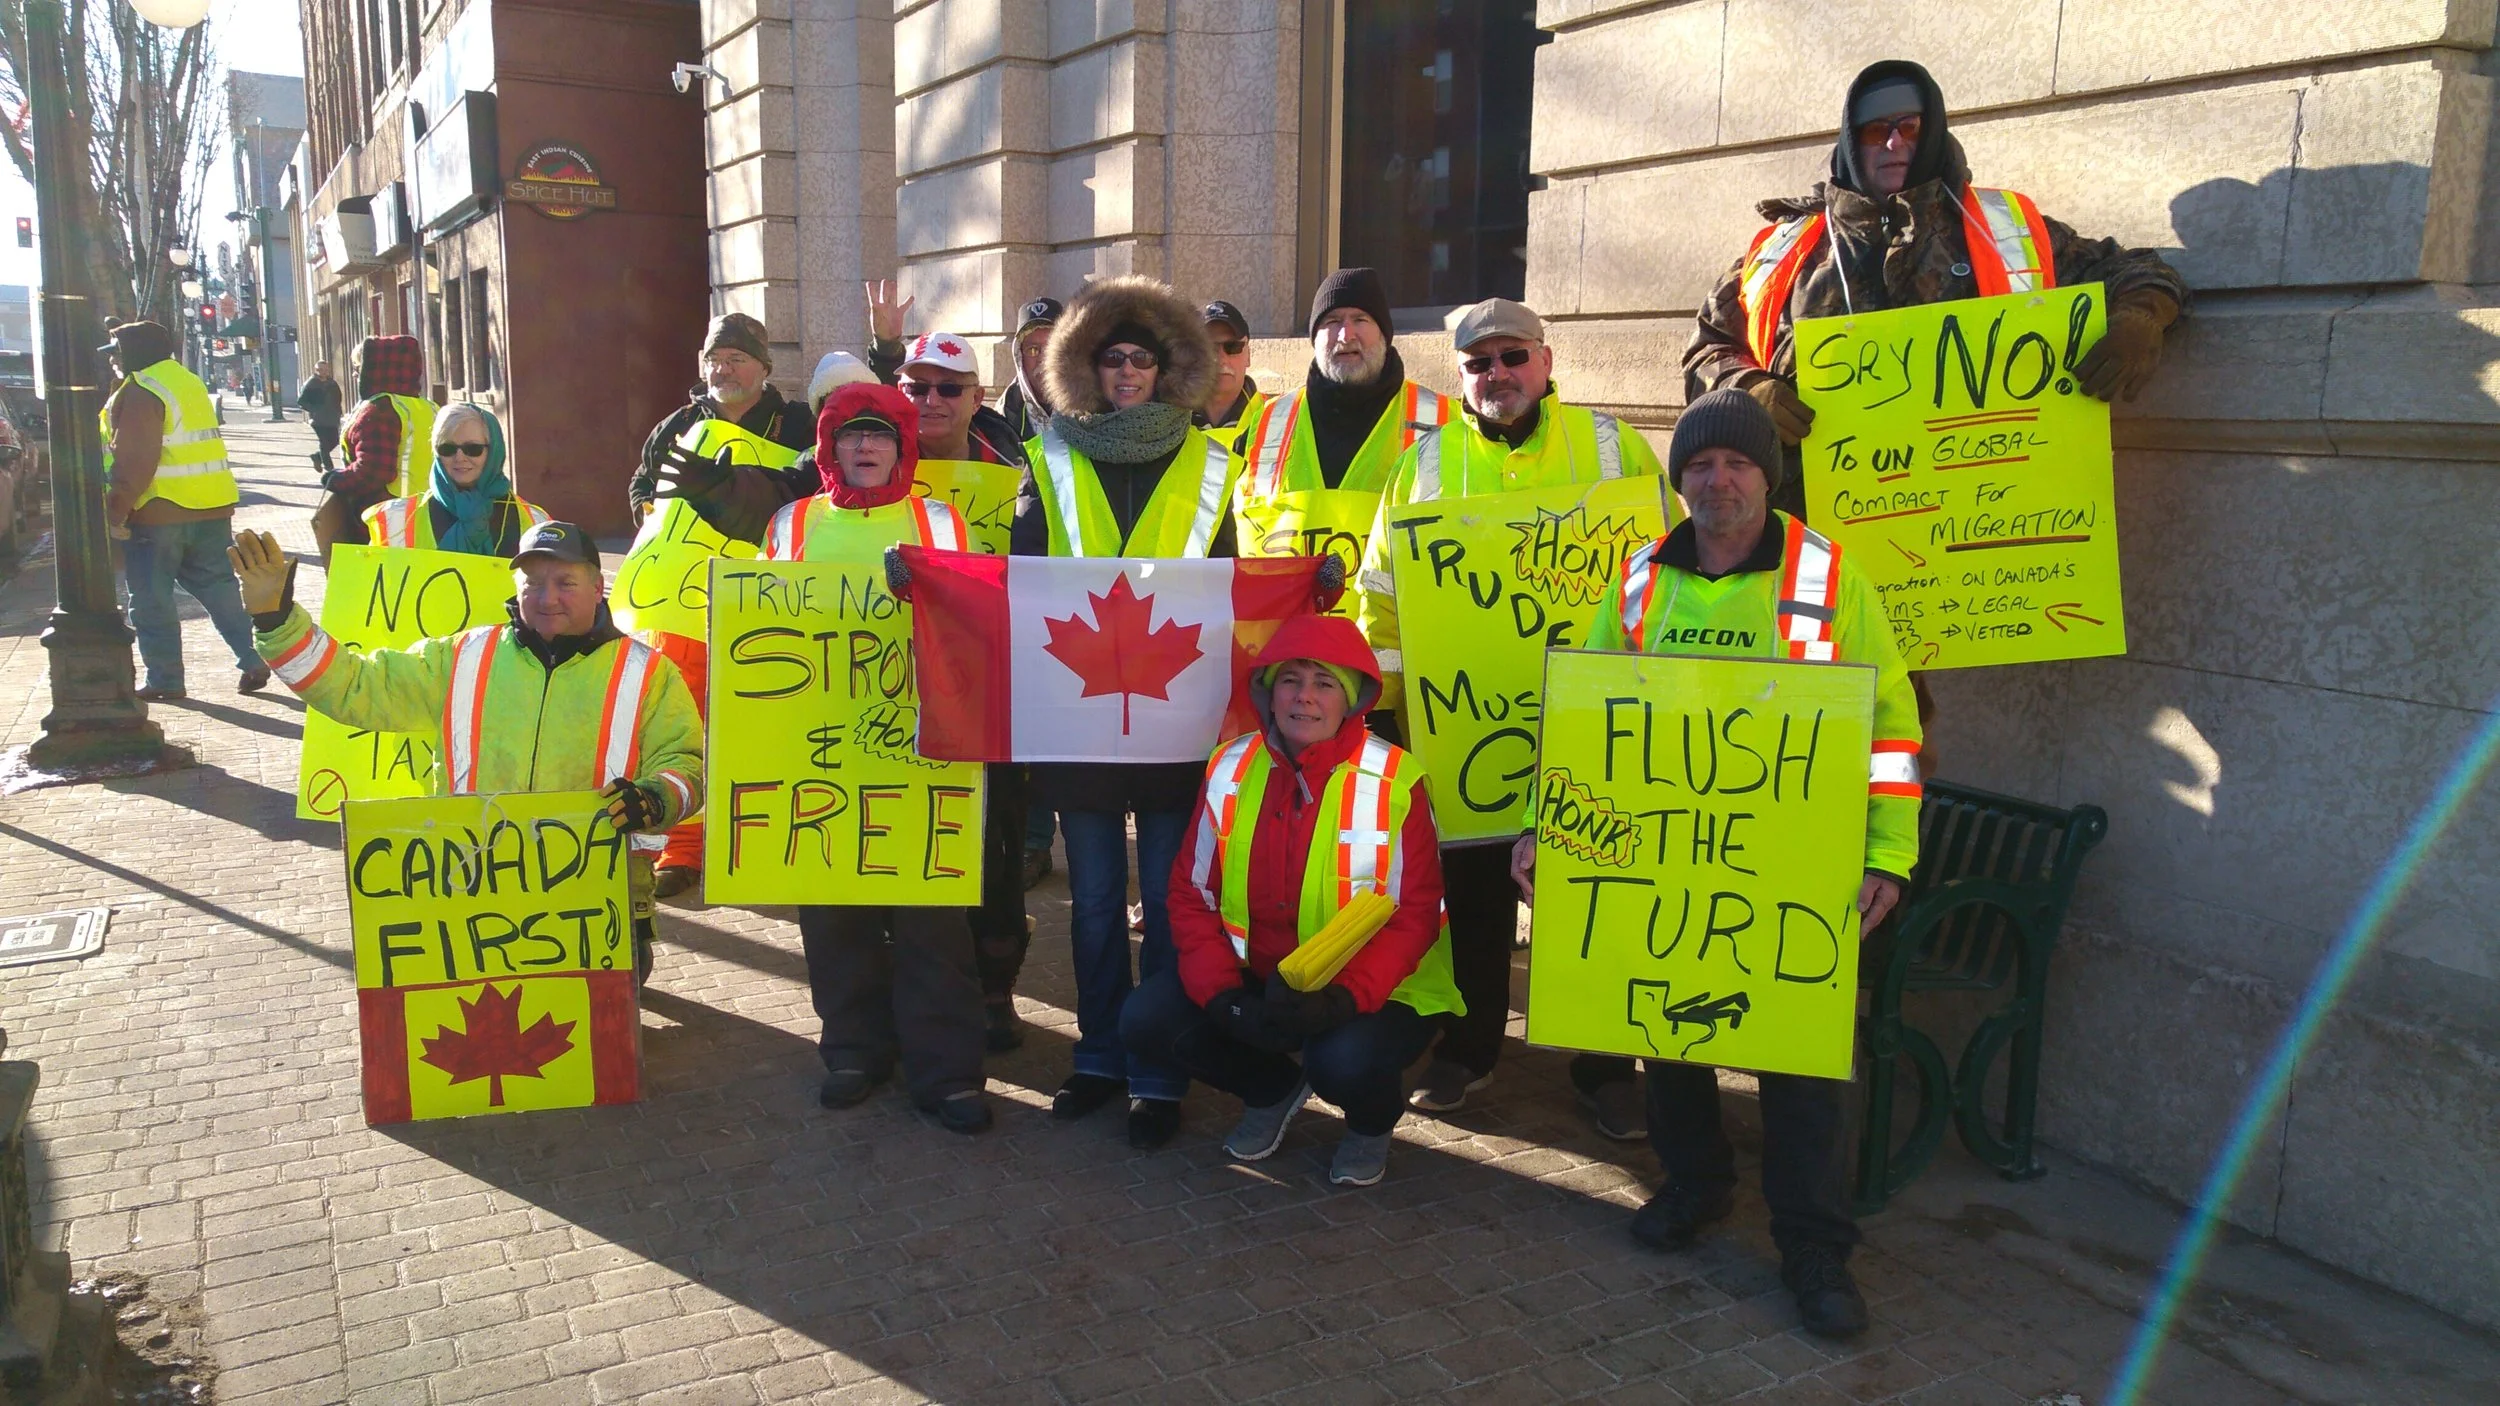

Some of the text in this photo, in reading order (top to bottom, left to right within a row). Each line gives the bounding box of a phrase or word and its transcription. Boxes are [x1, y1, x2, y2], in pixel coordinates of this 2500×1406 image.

[540, 146, 567, 156] INDIAN
[511, 182, 563, 201] SPICE
[1932, 292, 2093, 410] NO!
[1872, 444, 1914, 473] UN
[1932, 431, 2049, 464] GLOBAL
[365, 563, 471, 638] NO
[723, 571, 824, 618] TRUE
[1961, 571, 1985, 587] ON
[1966, 596, 2039, 616] LEGAL
[1964, 621, 2033, 642] VETTED
[1604, 697, 1824, 802] FLUSH
[353, 808, 627, 899] CANADA
[728, 778, 976, 881] FREE
[1540, 779, 1632, 864] HONK
[1634, 808, 1758, 877] THE
[378, 897, 622, 989] FIRST!
[1567, 876, 1851, 990] TURD!
